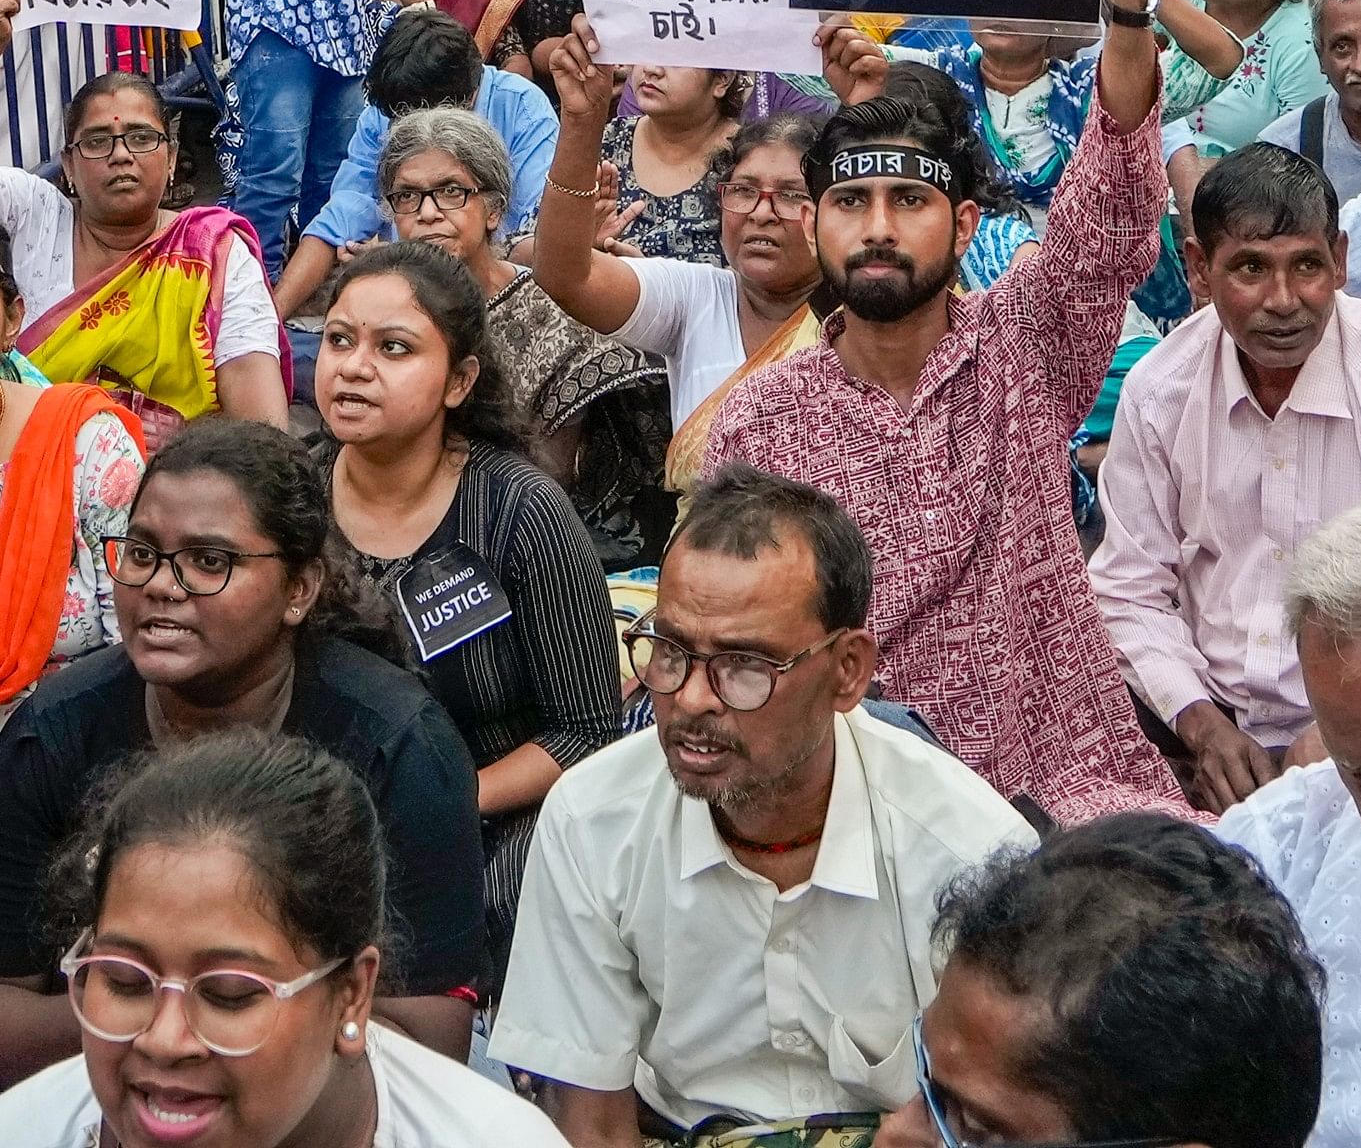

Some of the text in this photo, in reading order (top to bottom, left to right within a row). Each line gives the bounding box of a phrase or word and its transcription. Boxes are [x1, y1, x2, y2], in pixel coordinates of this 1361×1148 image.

[829, 151, 953, 191] বিচার চাই
[414, 566, 476, 604] WE DEMAND
[419, 581, 492, 633] JUSTICE
